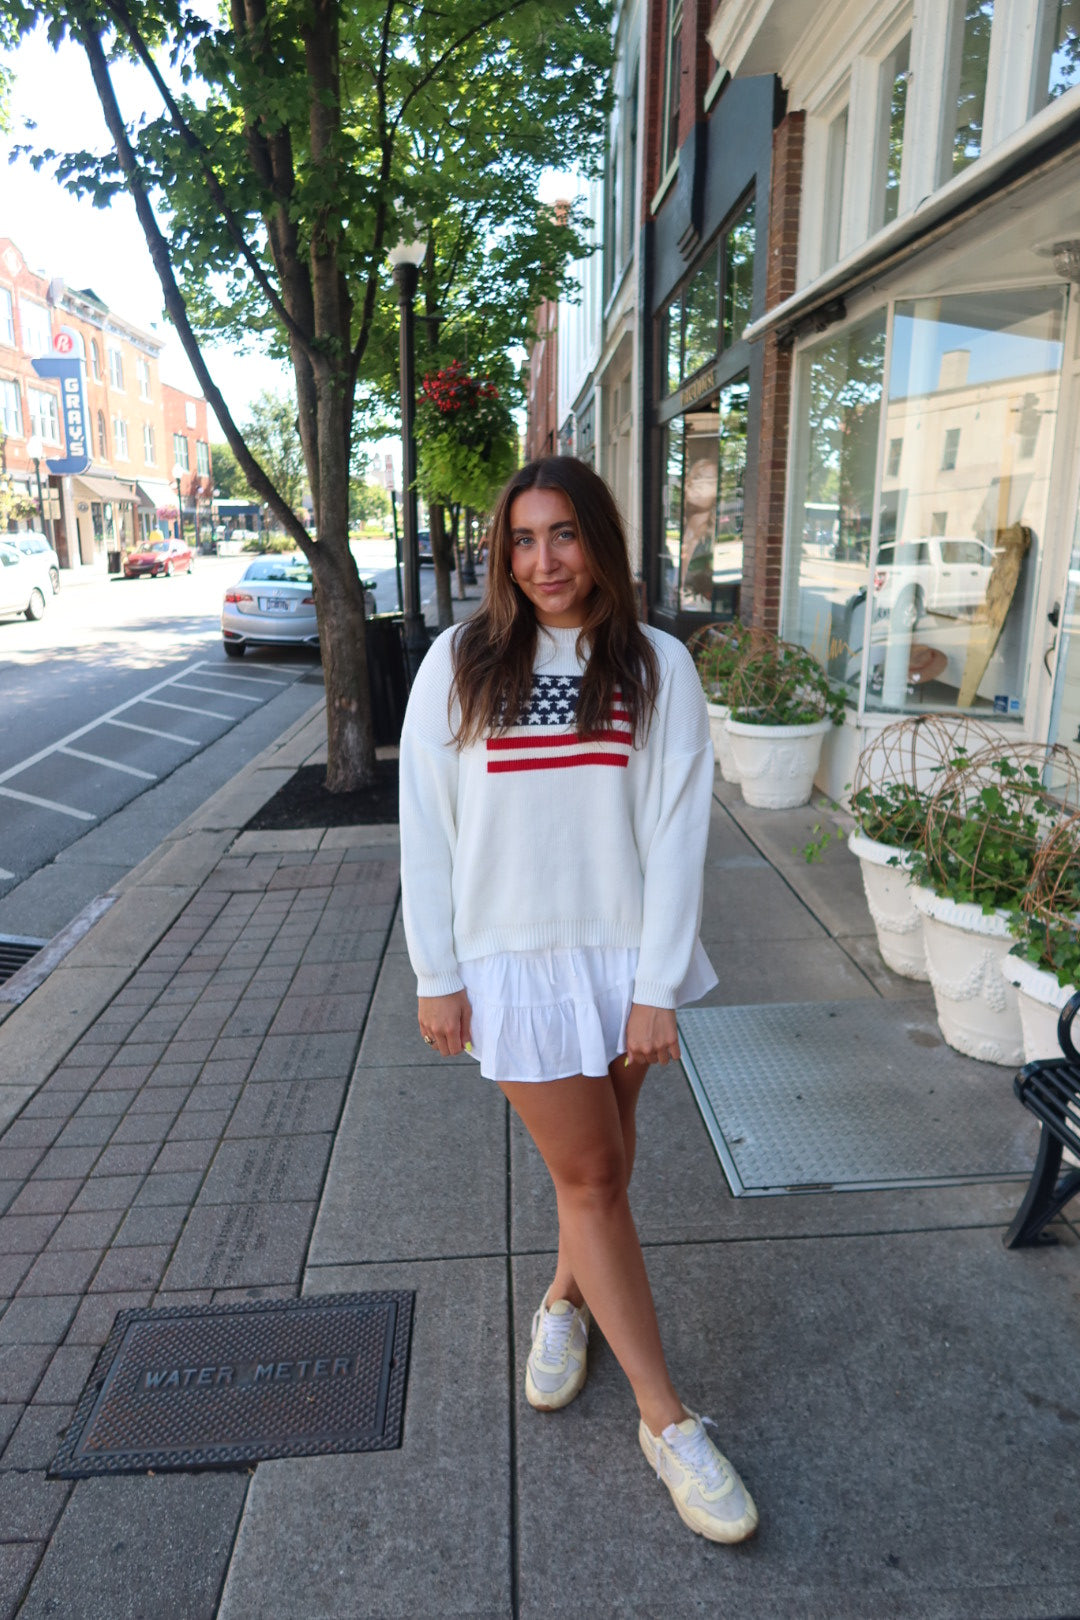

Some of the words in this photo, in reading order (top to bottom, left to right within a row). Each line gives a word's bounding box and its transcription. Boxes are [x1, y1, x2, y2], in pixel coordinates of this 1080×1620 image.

[64, 378, 85, 457] GRAY'S
[144, 1366, 235, 1388] WATER
[253, 1358, 351, 1382] METER
